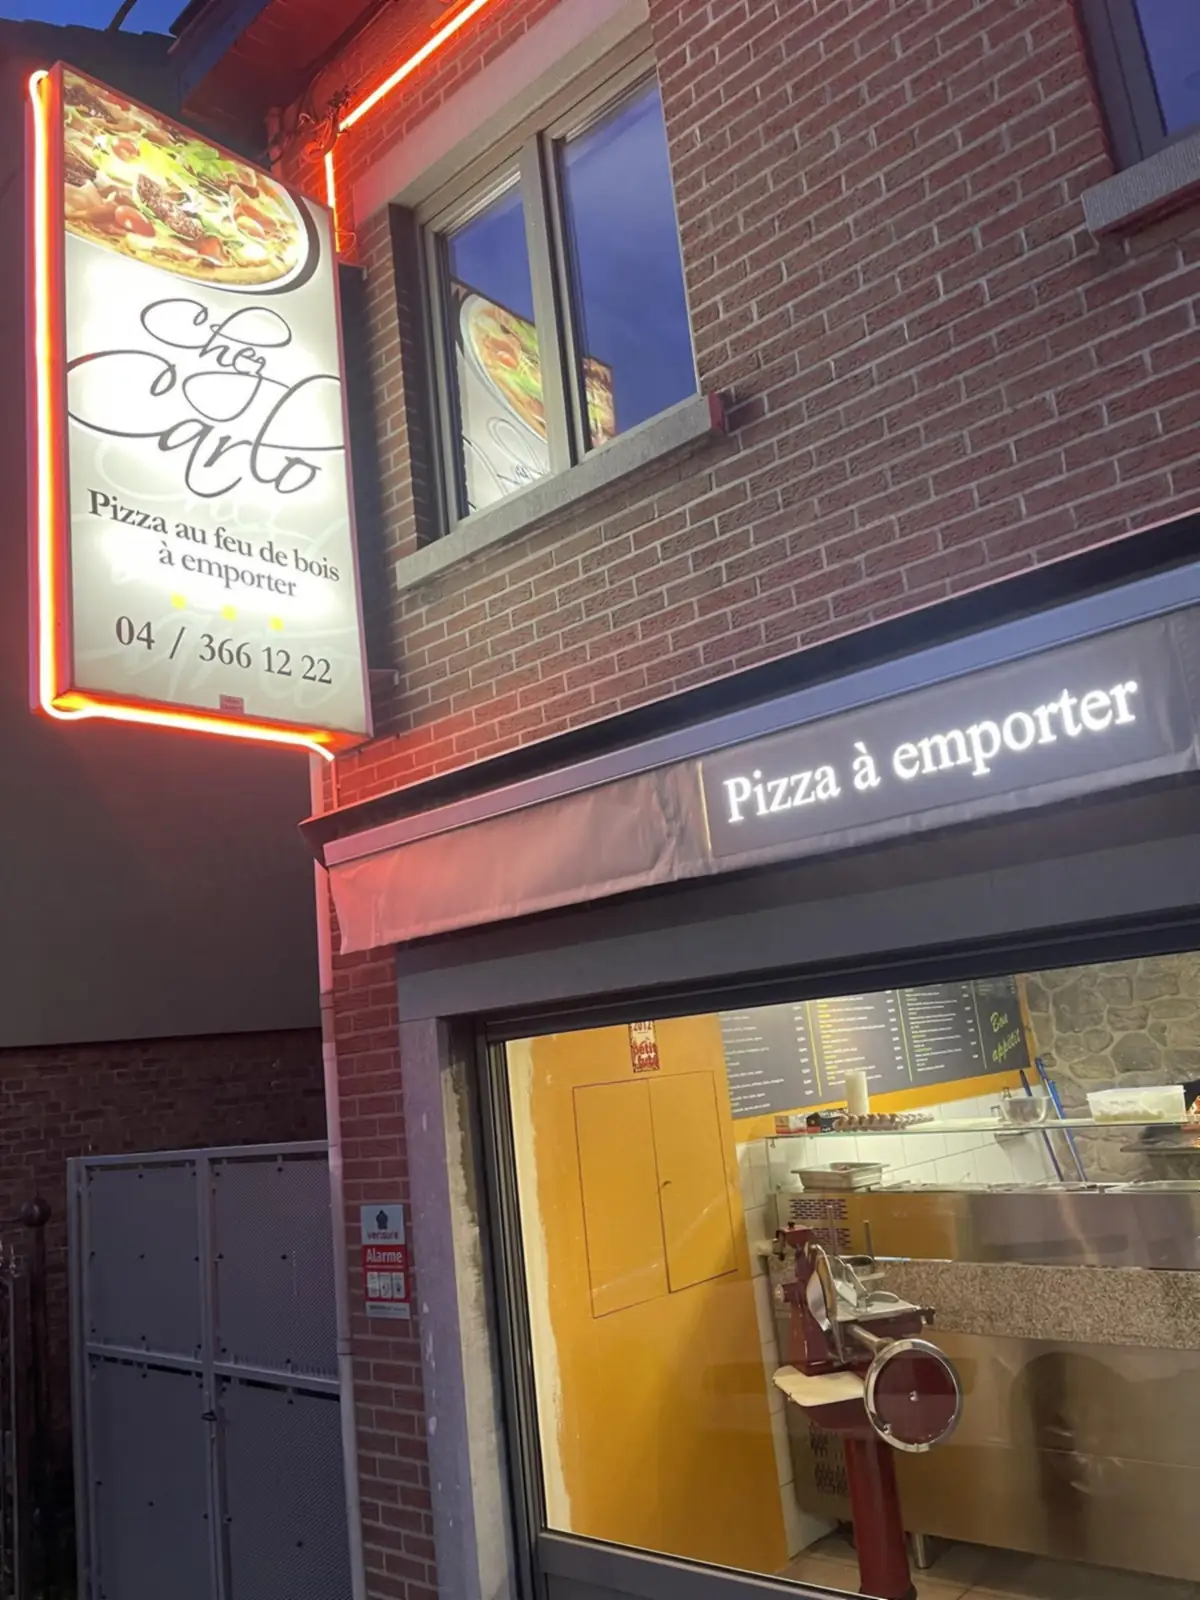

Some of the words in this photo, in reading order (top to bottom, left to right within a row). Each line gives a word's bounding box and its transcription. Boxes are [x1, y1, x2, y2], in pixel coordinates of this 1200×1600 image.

[140, 298, 292, 422] Chez
[67, 349, 346, 498] Carlo
[87, 488, 168, 534] Pizza
[175, 521, 207, 546] au
[214, 526, 252, 557] feu
[259, 541, 288, 567] de
[294, 549, 340, 582] bois
[159, 540, 174, 566] à
[181, 553, 297, 598] emporter
[115, 615, 156, 651] 04
[168, 626, 187, 660] /
[199, 633, 252, 669] 366
[262, 647, 292, 677] 12
[301, 655, 333, 685] 22
[722, 770, 841, 824] Pizza
[852, 741, 881, 793] à
[892, 680, 1139, 778] emporter
[366, 1248, 403, 1264] Alarme
